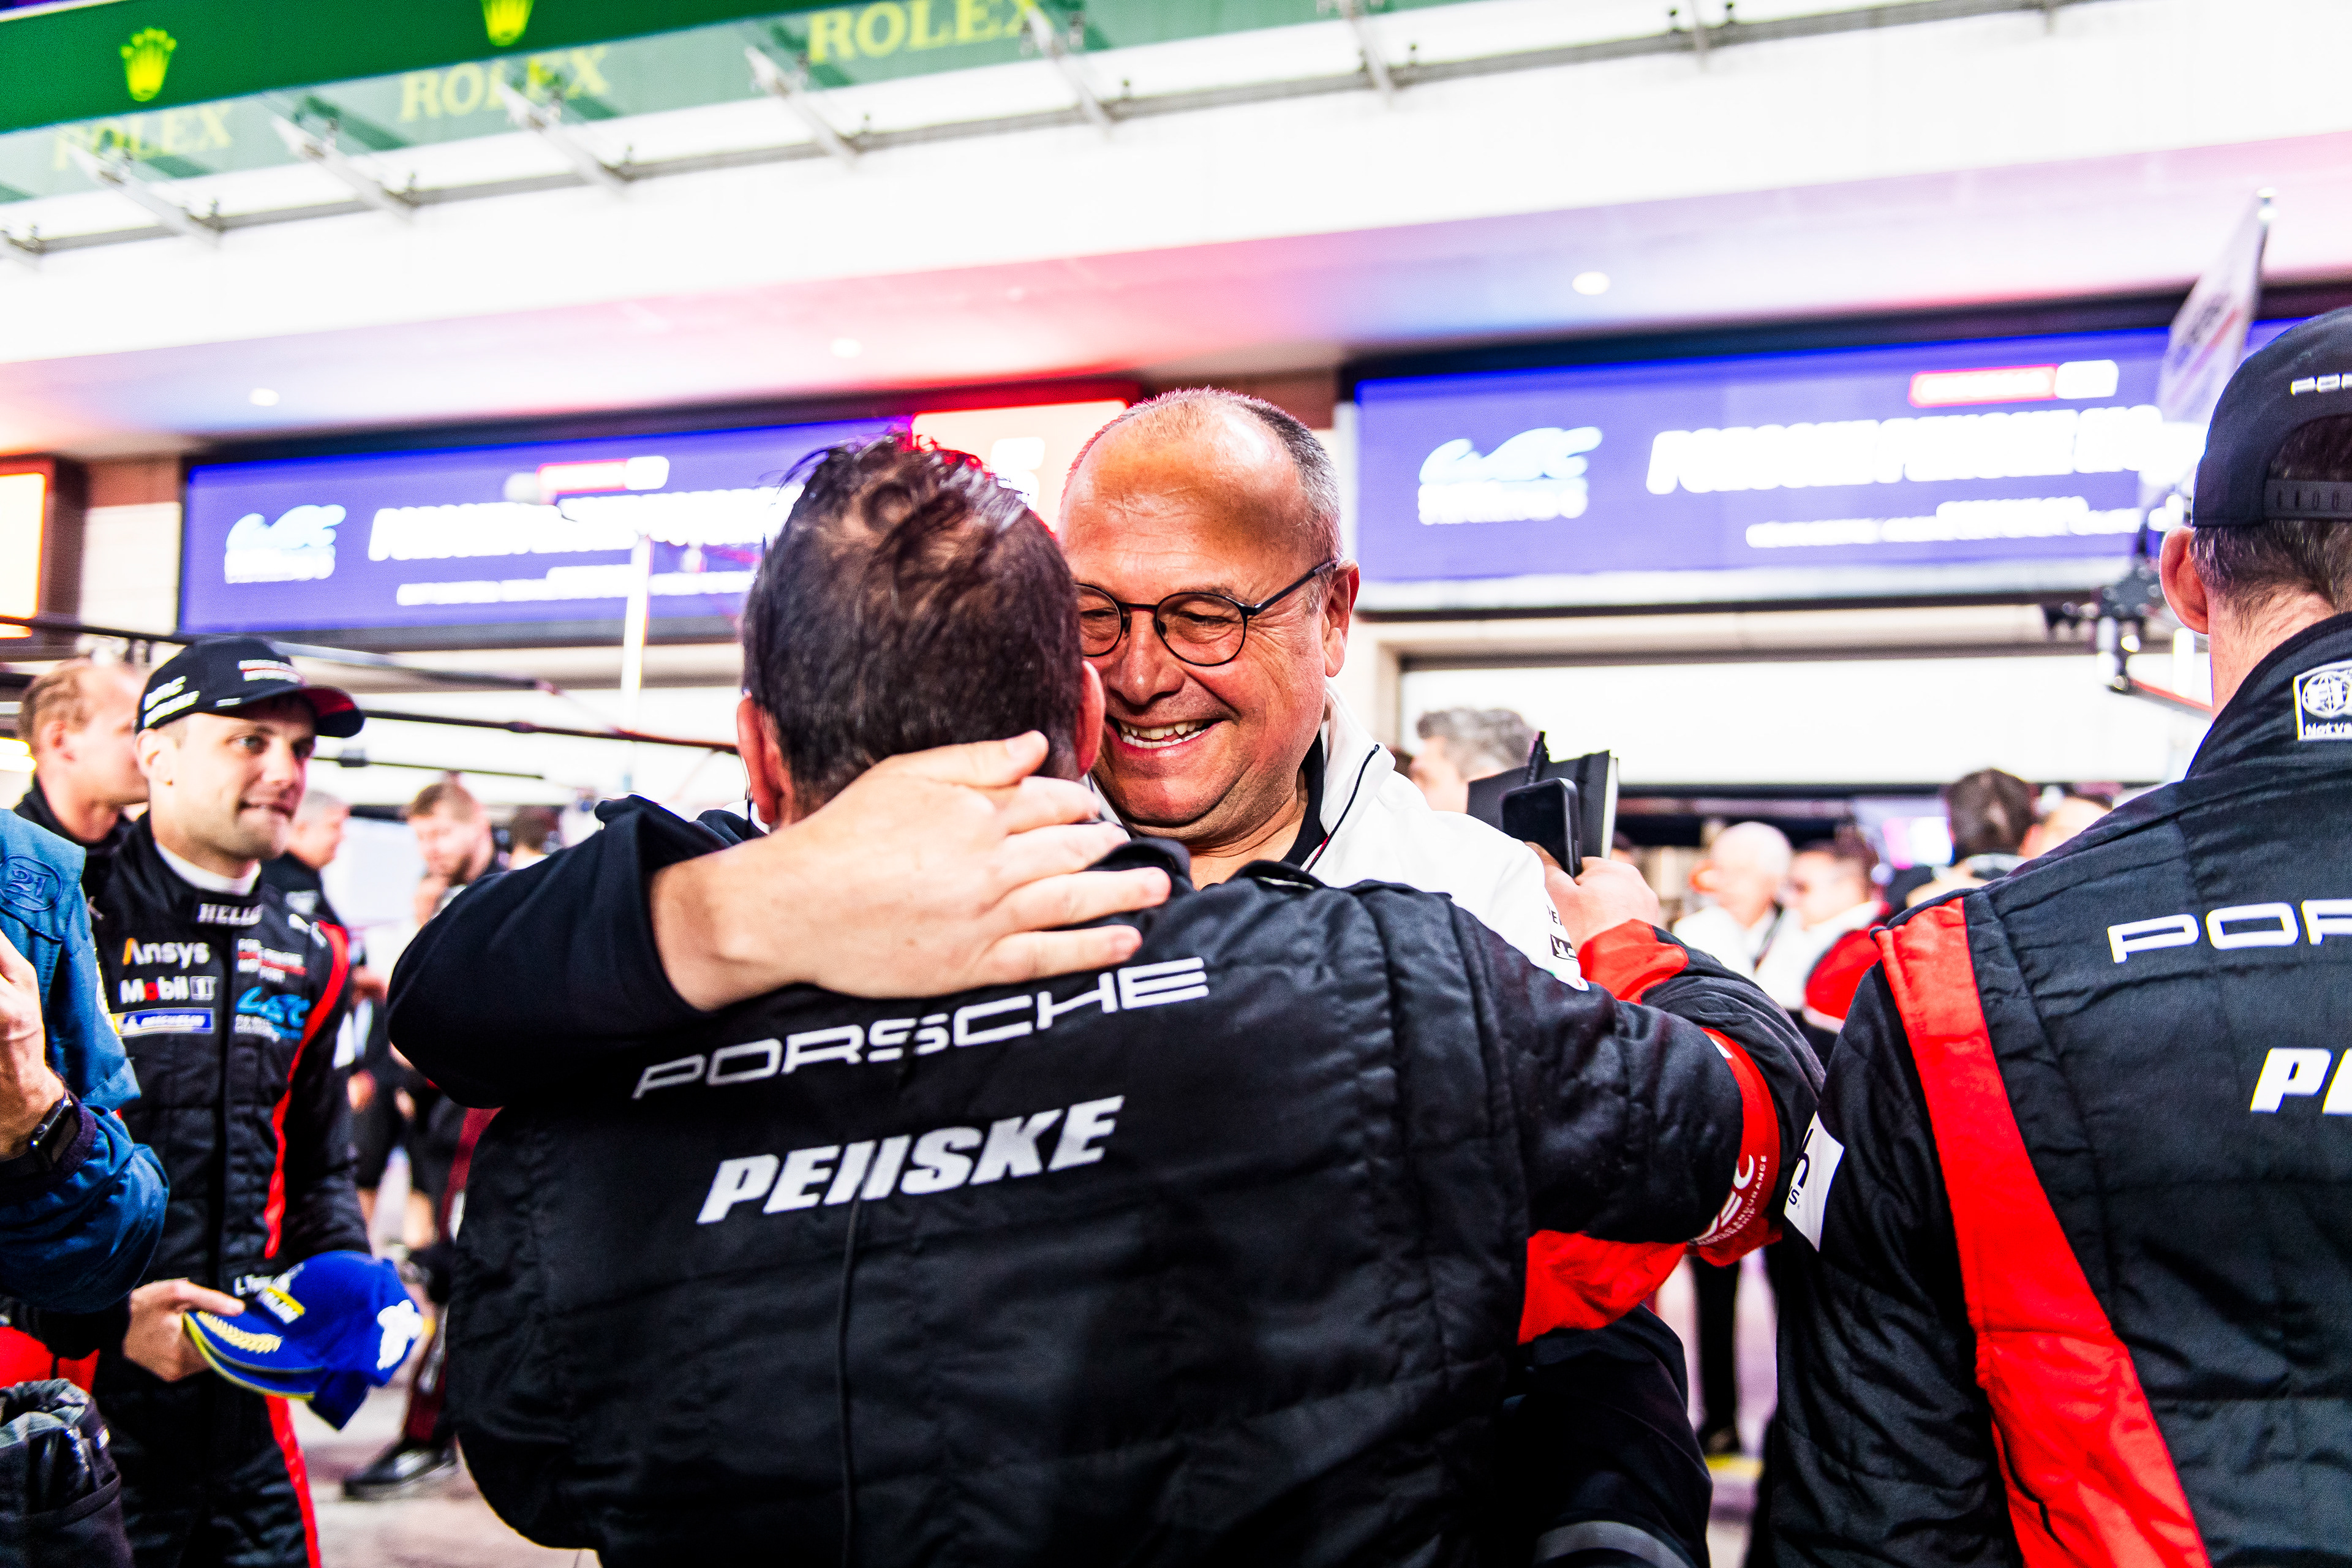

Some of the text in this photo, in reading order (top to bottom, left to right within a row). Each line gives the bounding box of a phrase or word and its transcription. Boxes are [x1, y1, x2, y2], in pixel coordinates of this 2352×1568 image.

[123, 937, 211, 969] Ansys
[119, 976, 188, 1004] Mobil
[632, 957, 1210, 1100] PORSCHE
